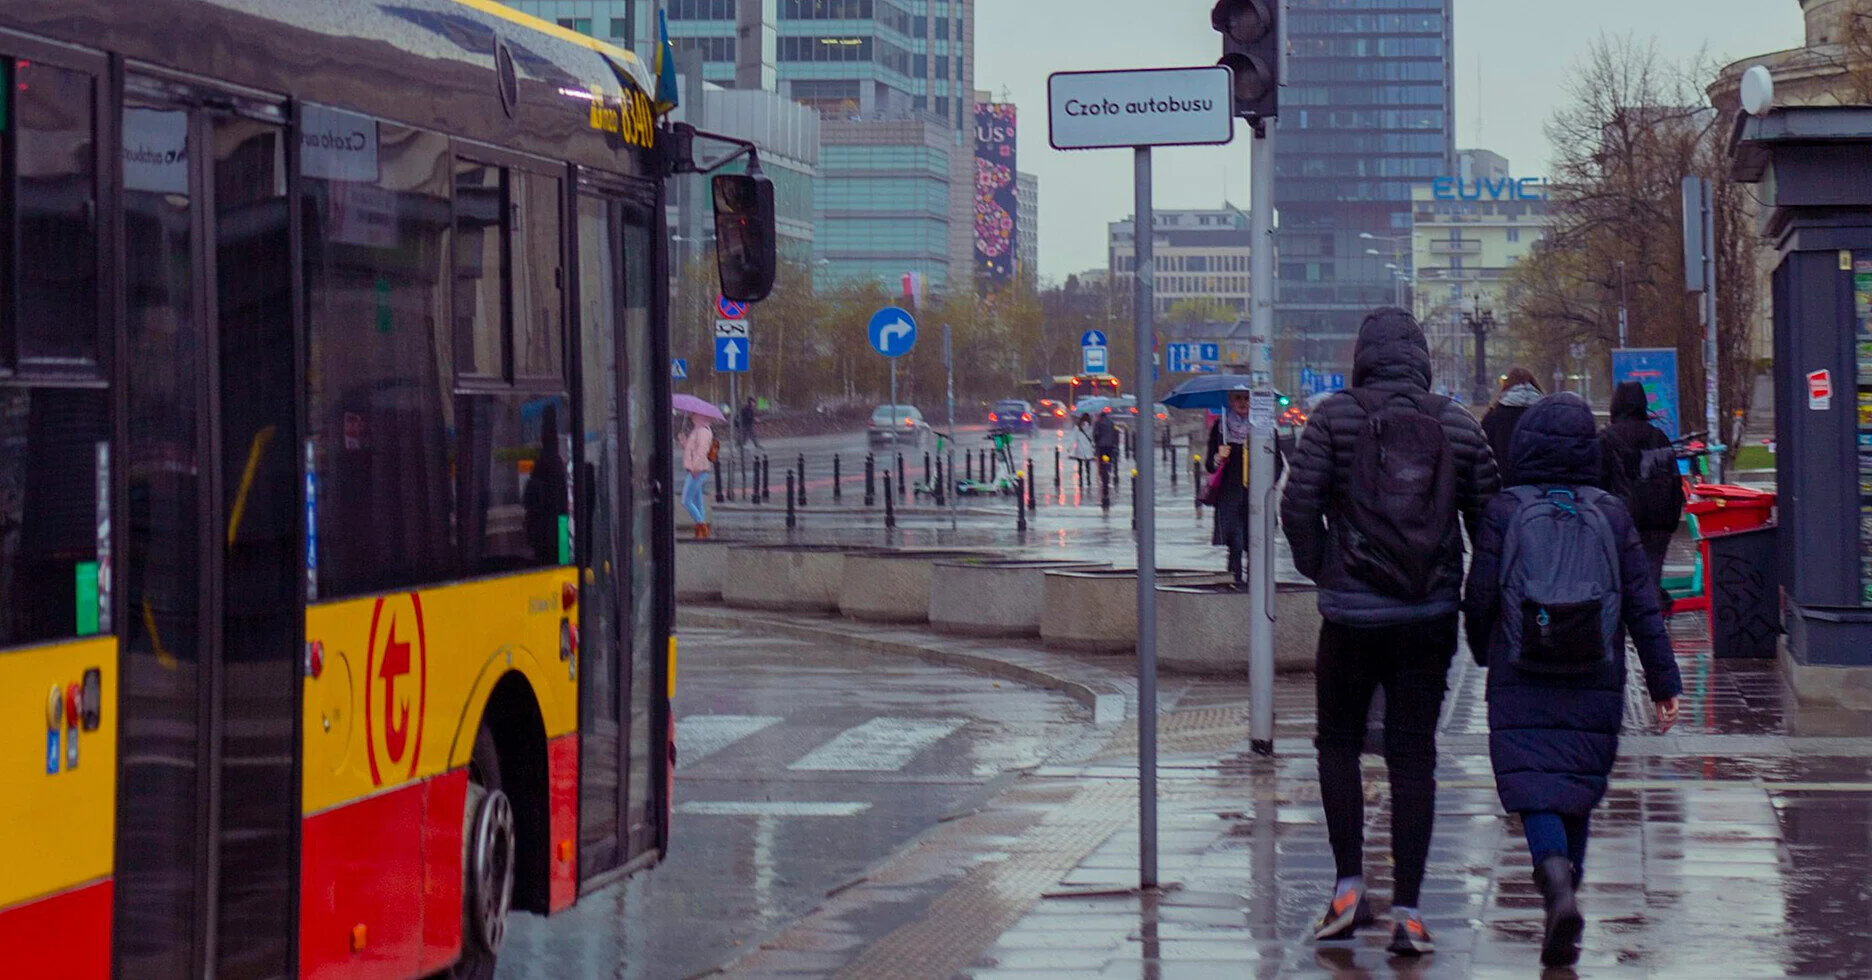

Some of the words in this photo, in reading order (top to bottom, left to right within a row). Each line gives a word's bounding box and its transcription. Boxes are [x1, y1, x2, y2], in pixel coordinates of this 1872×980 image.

[1065, 97, 1120, 116] Czoło
[1125, 95, 1213, 114] autobusu
[621, 87, 654, 149] 8340
[974, 126, 1005, 143] US
